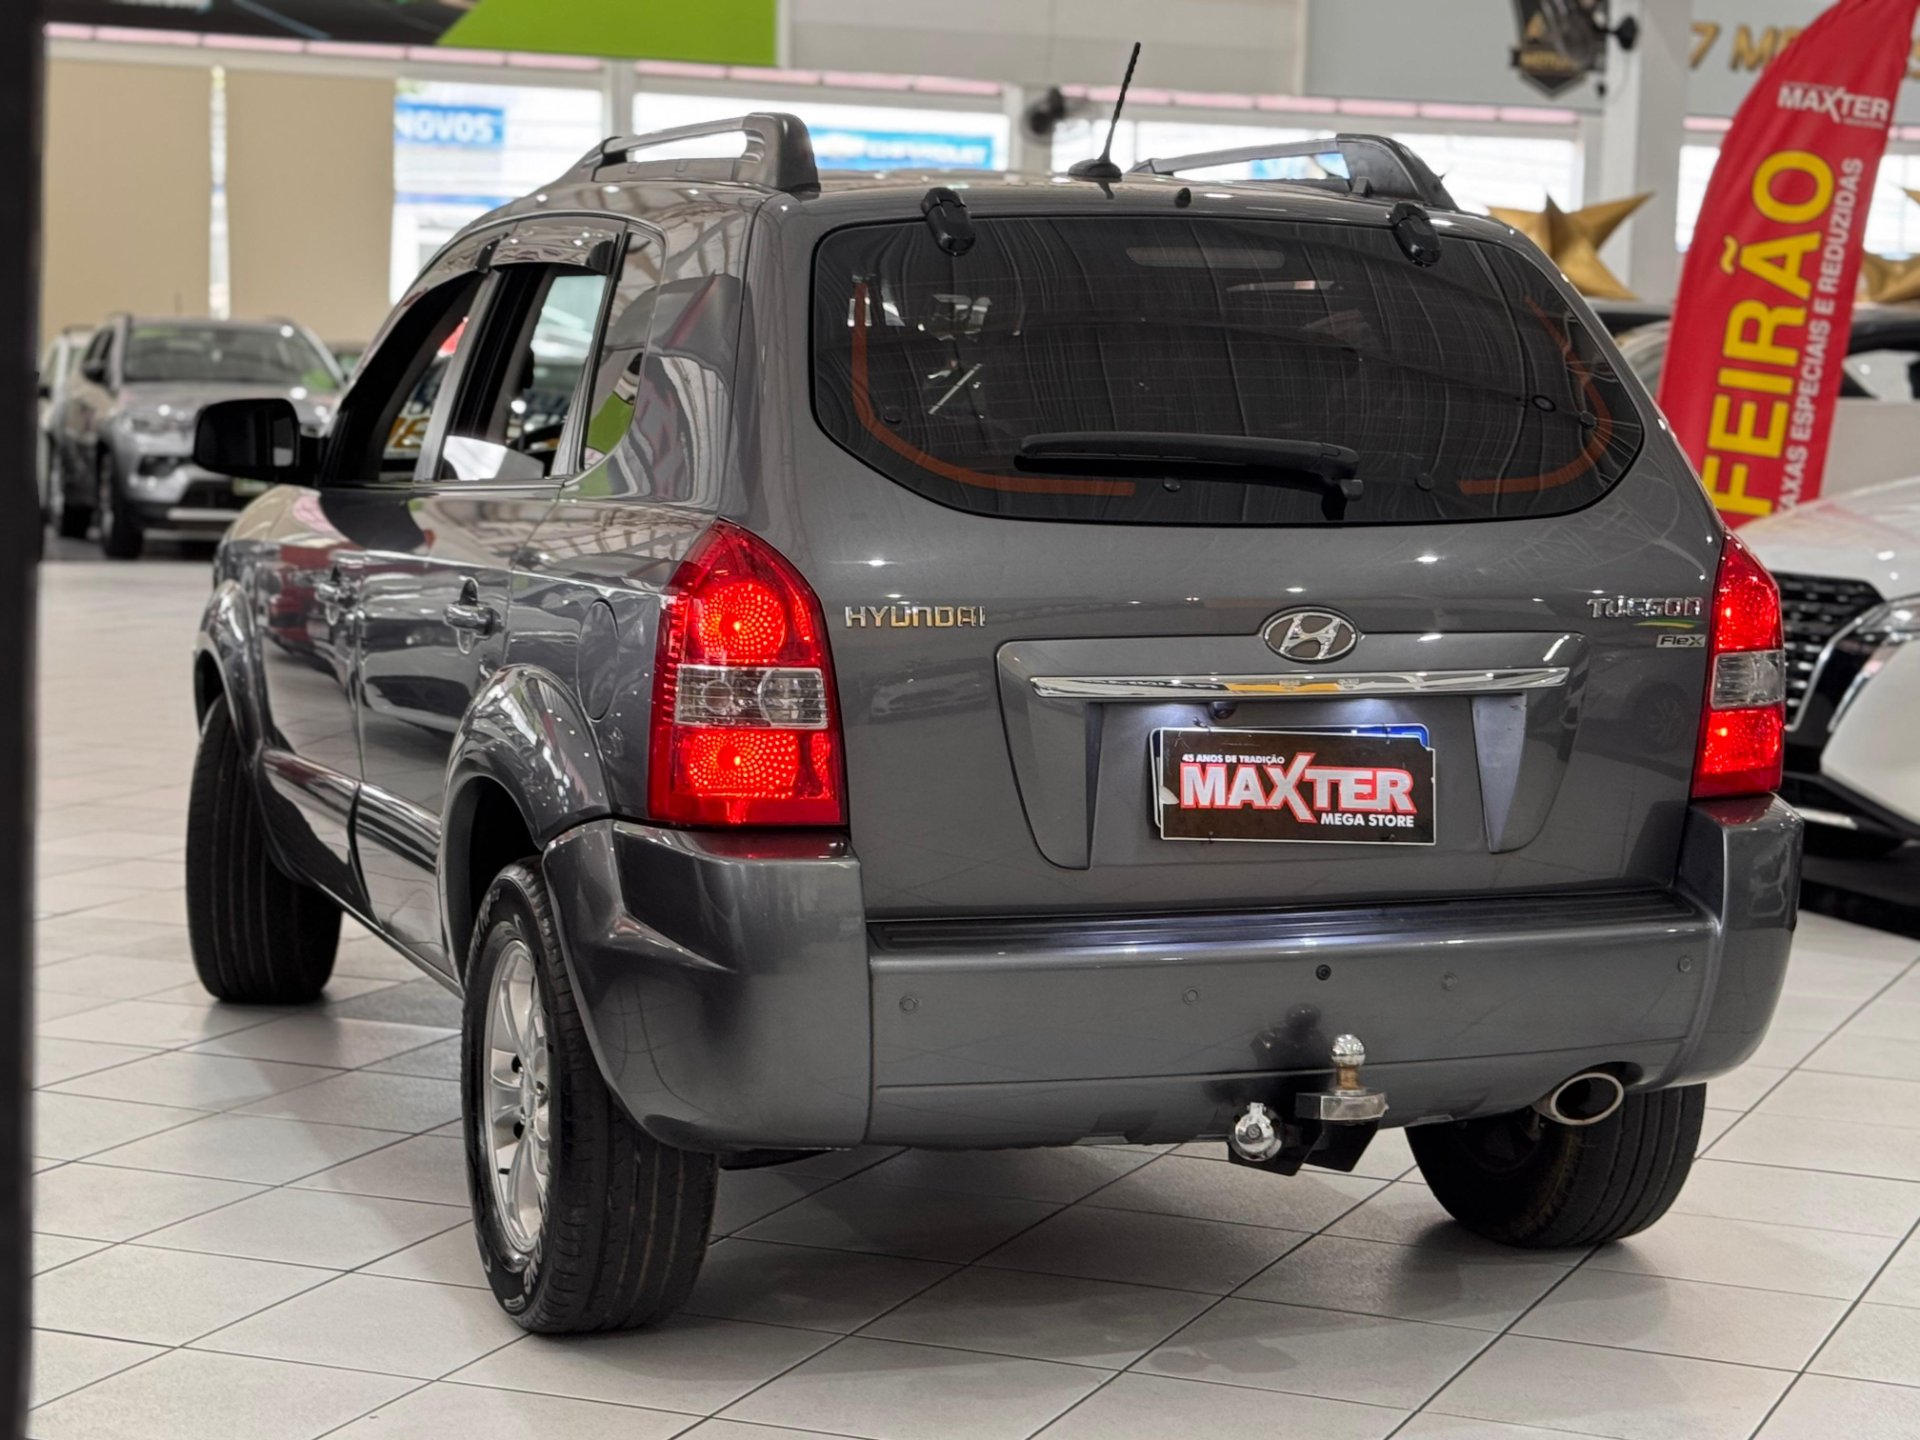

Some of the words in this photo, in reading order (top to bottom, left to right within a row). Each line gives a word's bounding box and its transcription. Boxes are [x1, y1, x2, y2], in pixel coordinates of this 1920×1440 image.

[1777, 86, 1890, 125] MAXTER
[1817, 157, 1864, 294] REDUZIDAS
[1701, 150, 1835, 516] FEIRÃO
[1812, 297, 1836, 316] E
[1790, 319, 1831, 441] ESPECIAIS
[1777, 445, 1809, 515] AXAS
[844, 605, 986, 628] HYUNDAI
[1181, 753, 1195, 763] 45
[1196, 754, 1224, 763] ANOS
[1225, 755, 1238, 763] DE
[1239, 754, 1286, 766] TRADIÇÃO
[1180, 752, 1418, 824] MAXTER
[1320, 812, 1366, 827] MEGA
[1368, 814, 1415, 828] STORE
